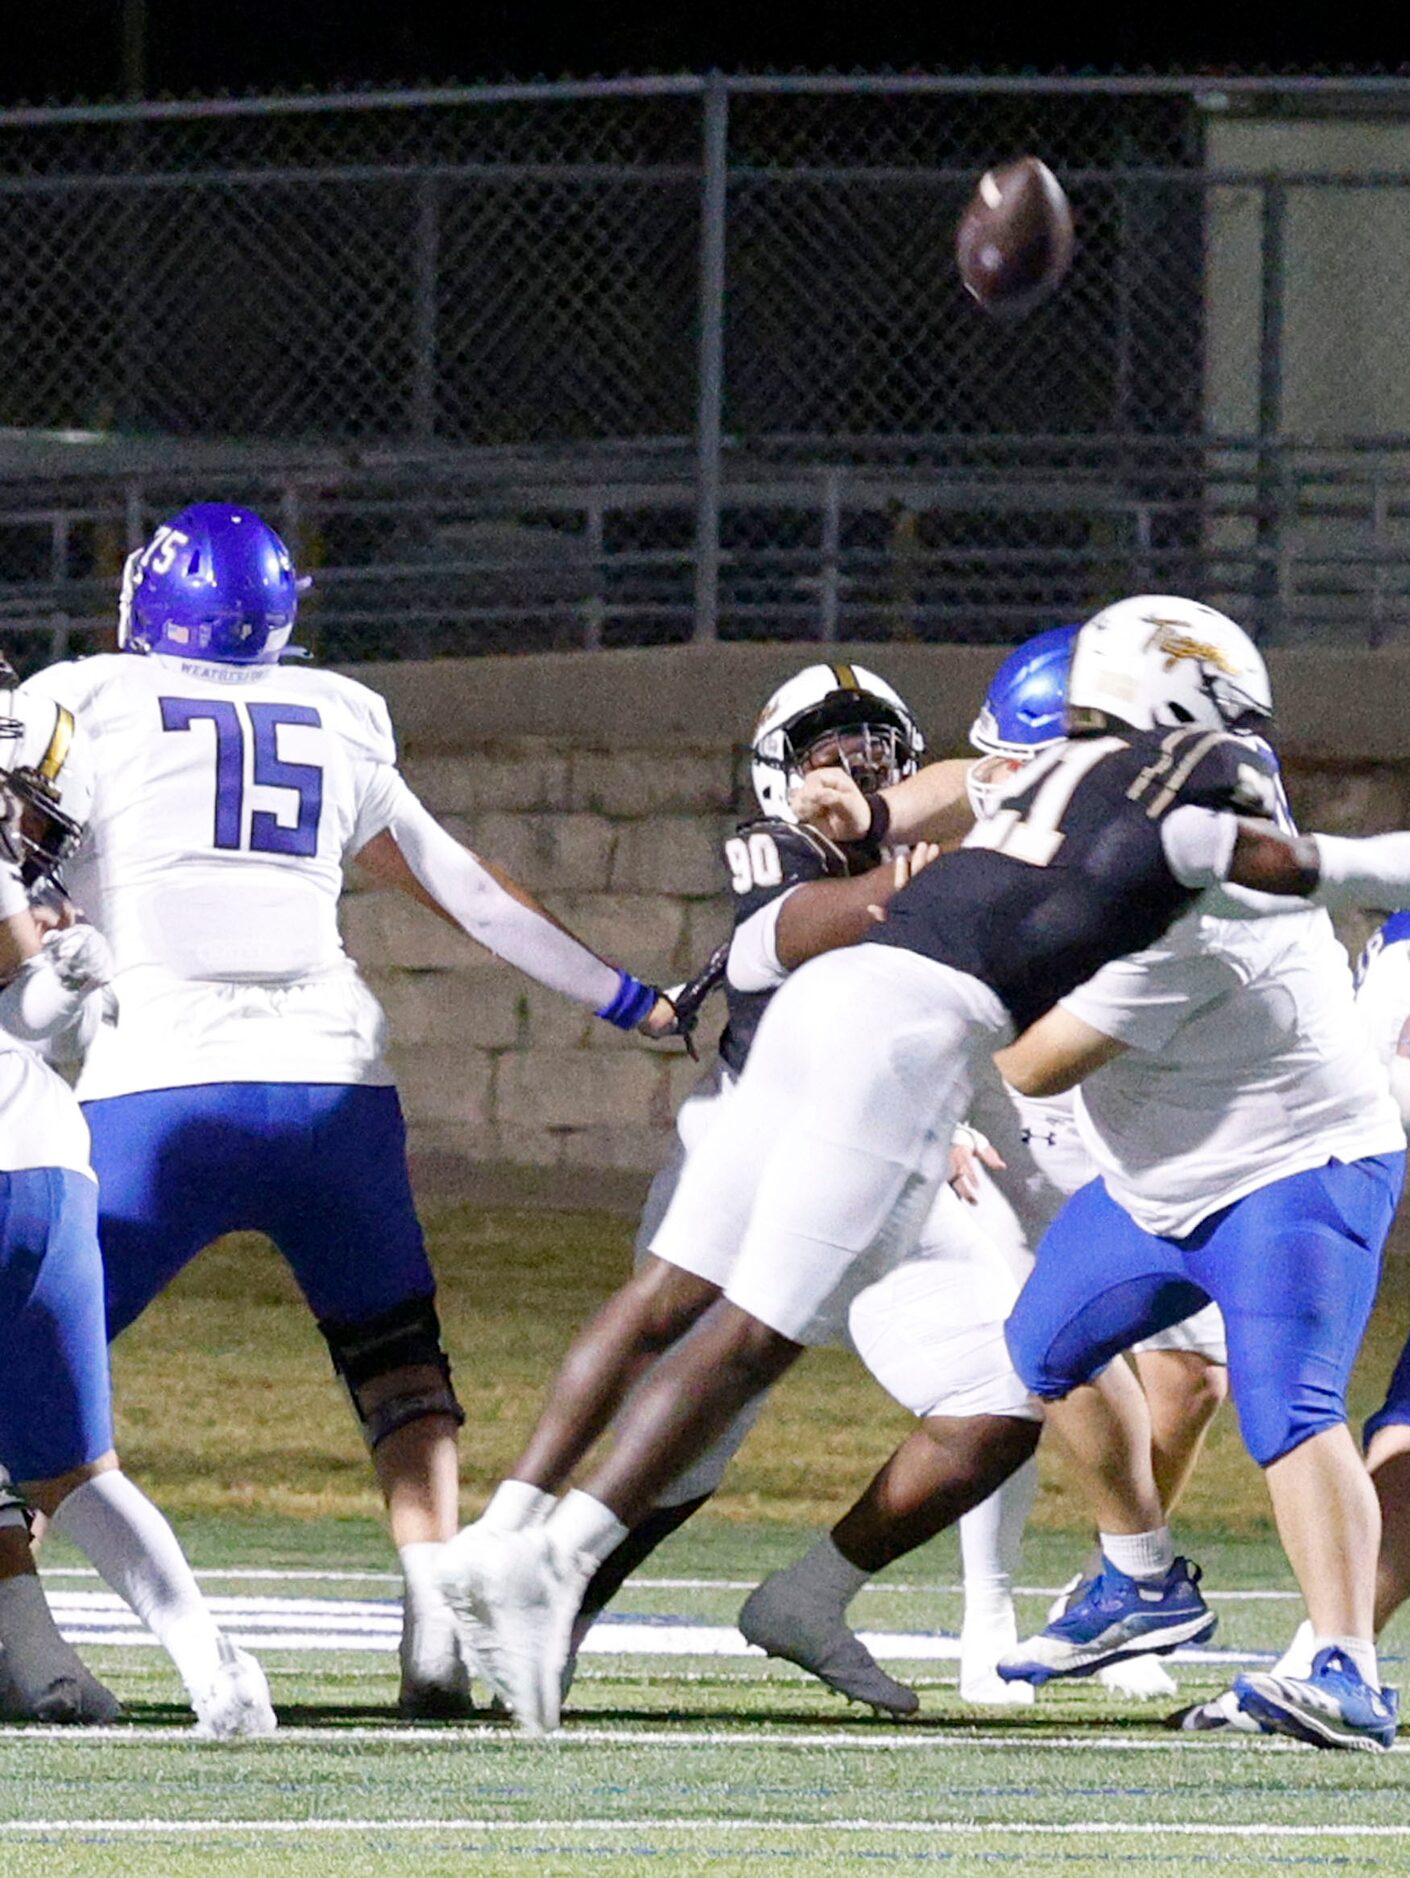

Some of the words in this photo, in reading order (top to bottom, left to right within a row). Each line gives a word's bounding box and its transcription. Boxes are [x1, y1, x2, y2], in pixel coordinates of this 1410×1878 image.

[140, 524, 190, 576] 75
[157, 695, 324, 859] 75
[724, 832, 783, 895] 90
